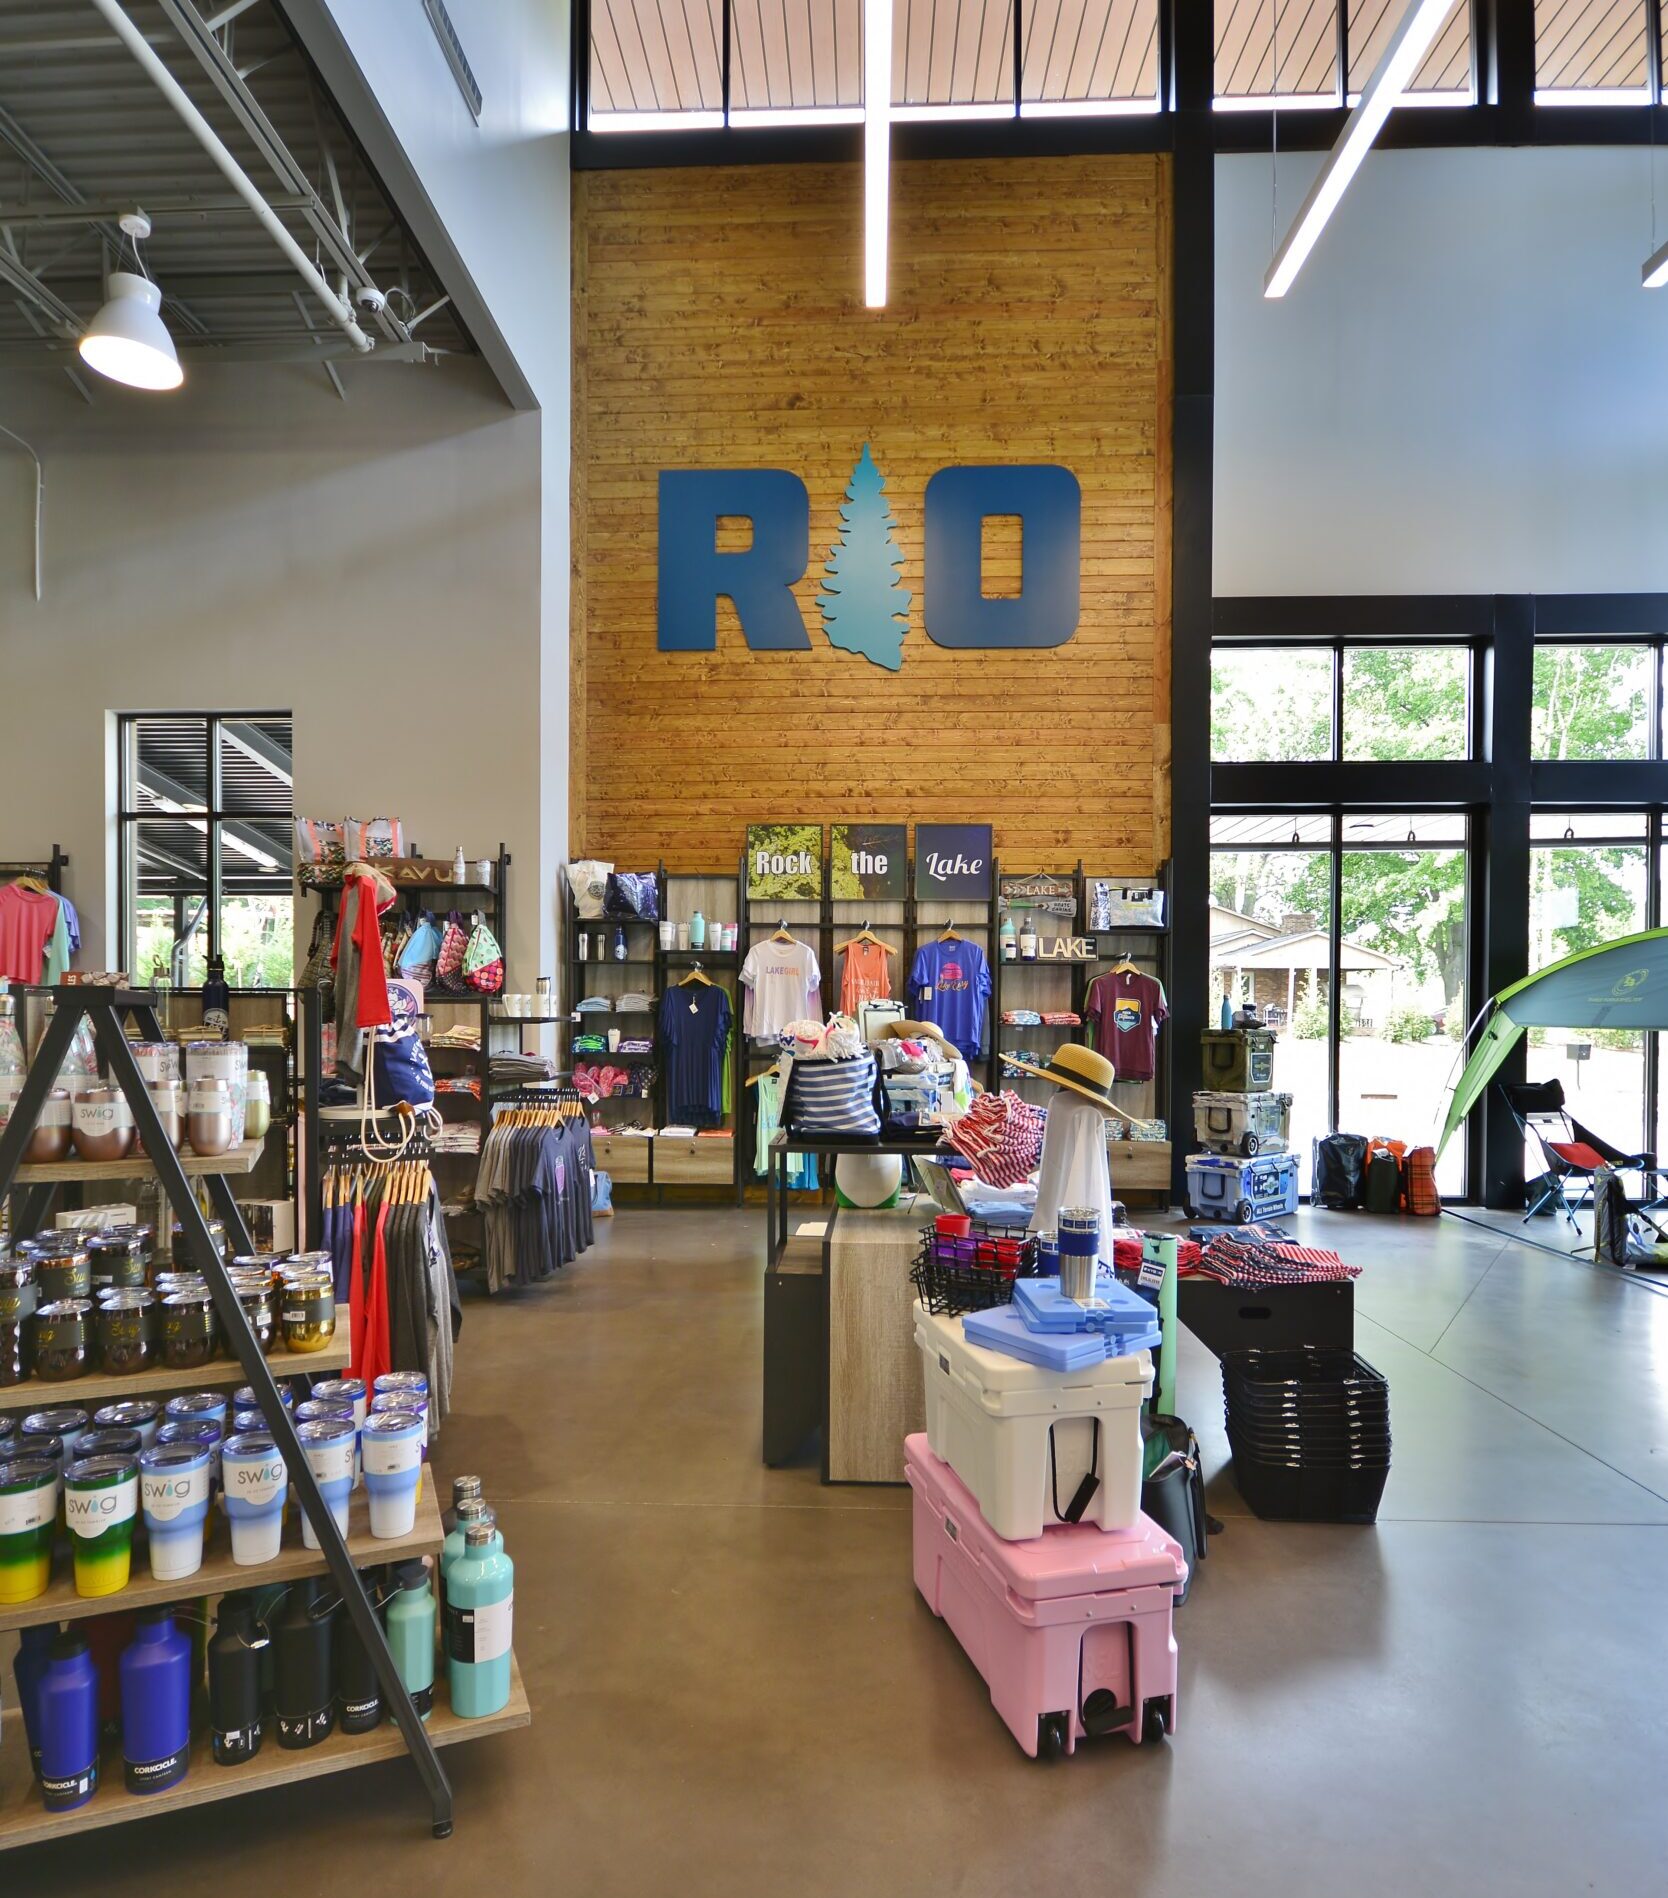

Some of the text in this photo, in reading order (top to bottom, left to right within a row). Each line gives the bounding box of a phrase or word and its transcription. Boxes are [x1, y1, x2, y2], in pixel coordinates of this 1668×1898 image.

[756, 851, 982, 881] Rock the Lake
[1026, 885, 1056, 895] LAKE
[1038, 937, 1097, 959] LAKE
[80, 1106, 114, 1120] swig
[238, 1464, 283, 1484] swig
[144, 1479, 191, 1498] swig
[68, 1495, 117, 1515] swig
